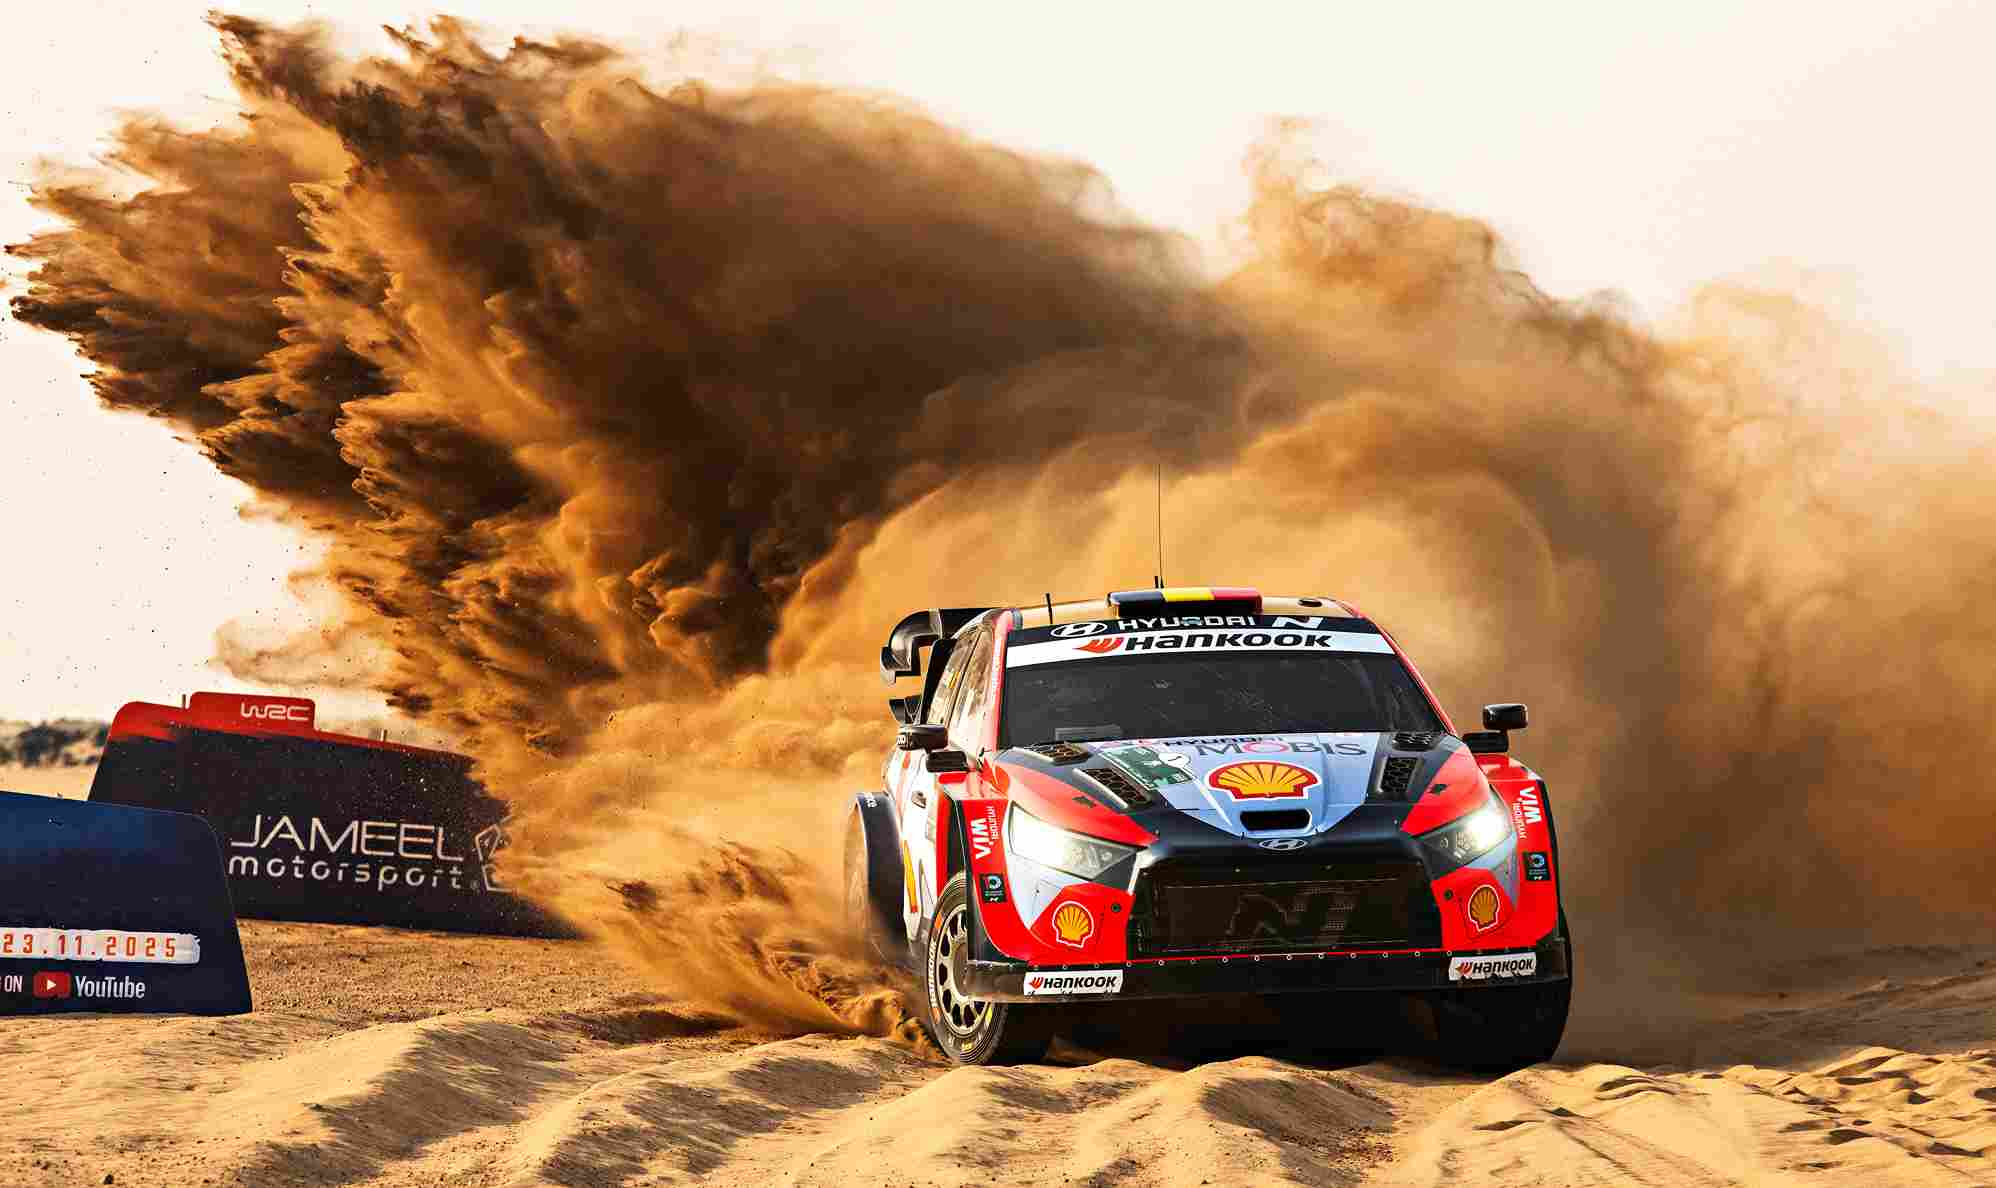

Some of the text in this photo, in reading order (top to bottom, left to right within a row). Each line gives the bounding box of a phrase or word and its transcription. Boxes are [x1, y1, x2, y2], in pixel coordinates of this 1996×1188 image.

[240, 703, 310, 721] WRC
[1196, 742, 1367, 756] MOBIS
[231, 814, 464, 862] JAMEEL
[229, 855, 464, 891] motorsport
[3, 933, 176, 958] 23.11.2025
[4, 974, 23, 993] ON
[75, 975, 146, 999] YouTube
